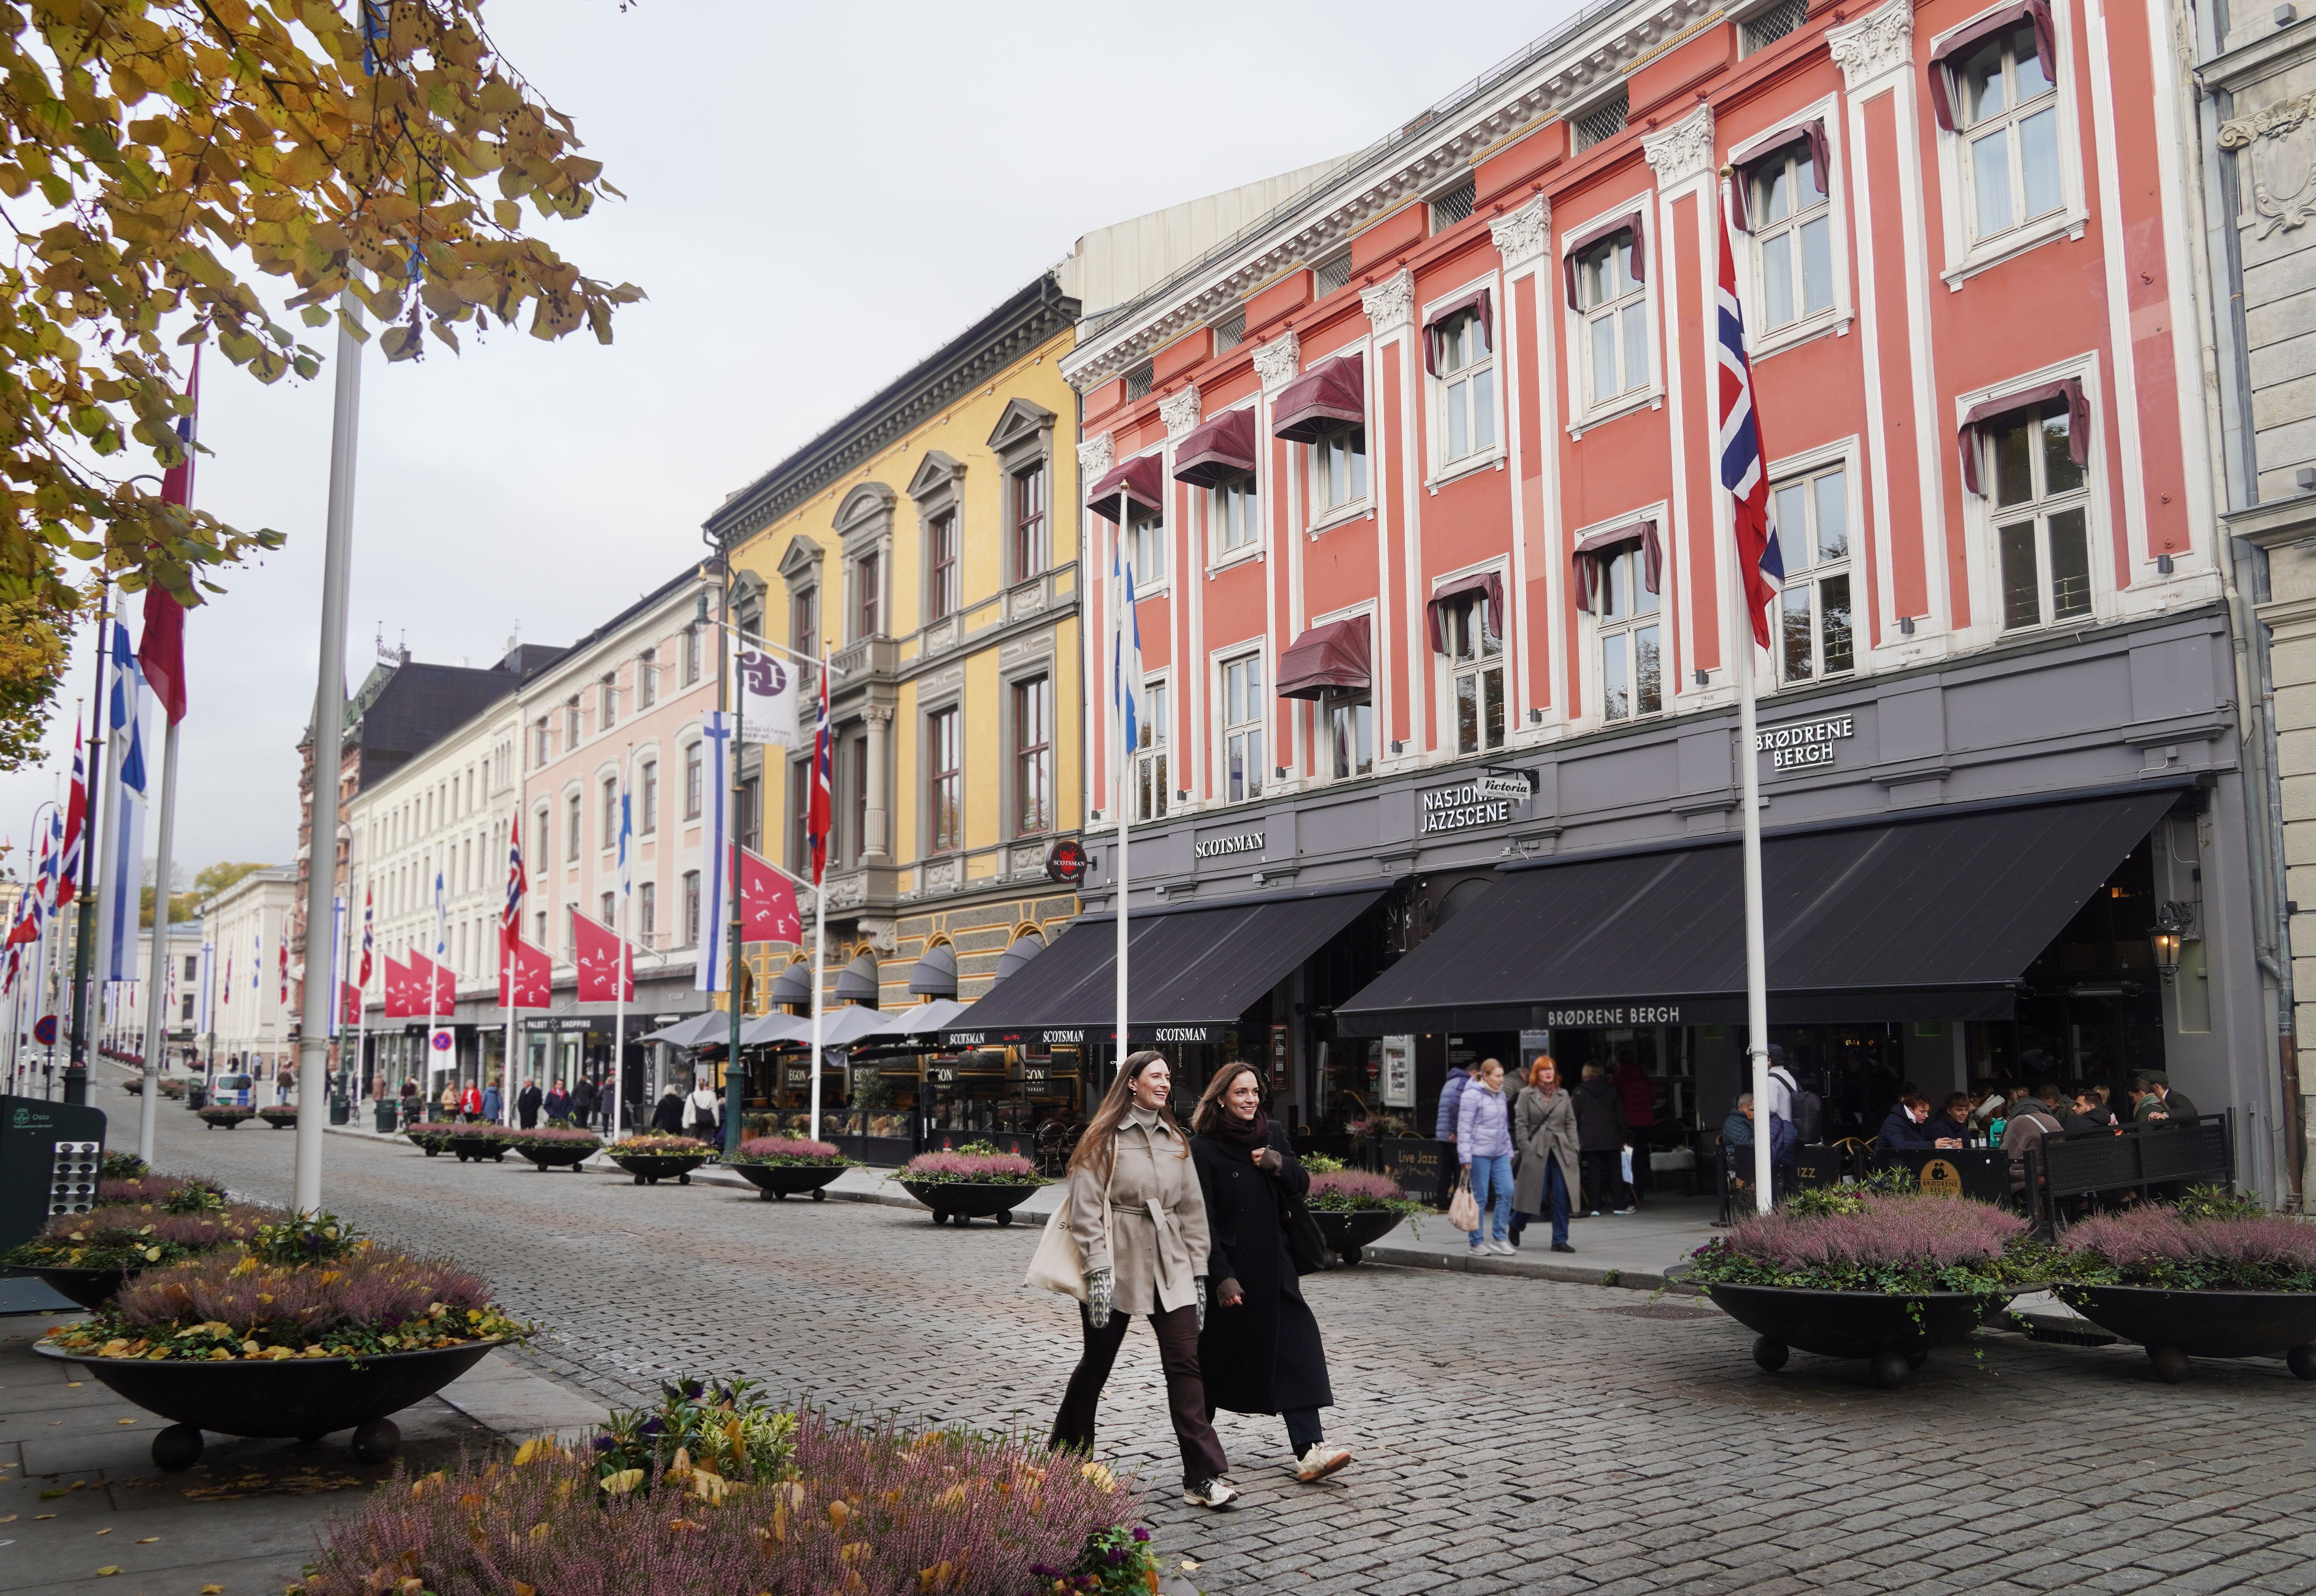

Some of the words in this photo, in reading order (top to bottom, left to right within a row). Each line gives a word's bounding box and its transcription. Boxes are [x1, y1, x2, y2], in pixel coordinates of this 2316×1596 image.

[1756, 719, 1852, 751] BRØDRENE
[1774, 742, 1834, 767] BERGH
[1485, 780, 1528, 793] Victoria
[1424, 785, 1495, 811] NASJON
[1420, 801, 1508, 832] JAZZSCENE
[1196, 832, 1263, 858] SCOTSMAN
[561, 1020, 590, 1028] SHOPPING
[1548, 1009, 1623, 1026] BRØDRENE
[1630, 1006, 1679, 1023] BERGH
[950, 1033, 985, 1044] SCOTSMAN
[1043, 1030, 1084, 1042] SCOTSMAN
[1156, 1028, 1207, 1041] SCOTSMAN
[789, 1070, 805, 1080] EGON
[1025, 1069, 1044, 1083] GON
[1398, 1150, 1415, 1163] Live
[1417, 1151, 1438, 1164] Jazz
